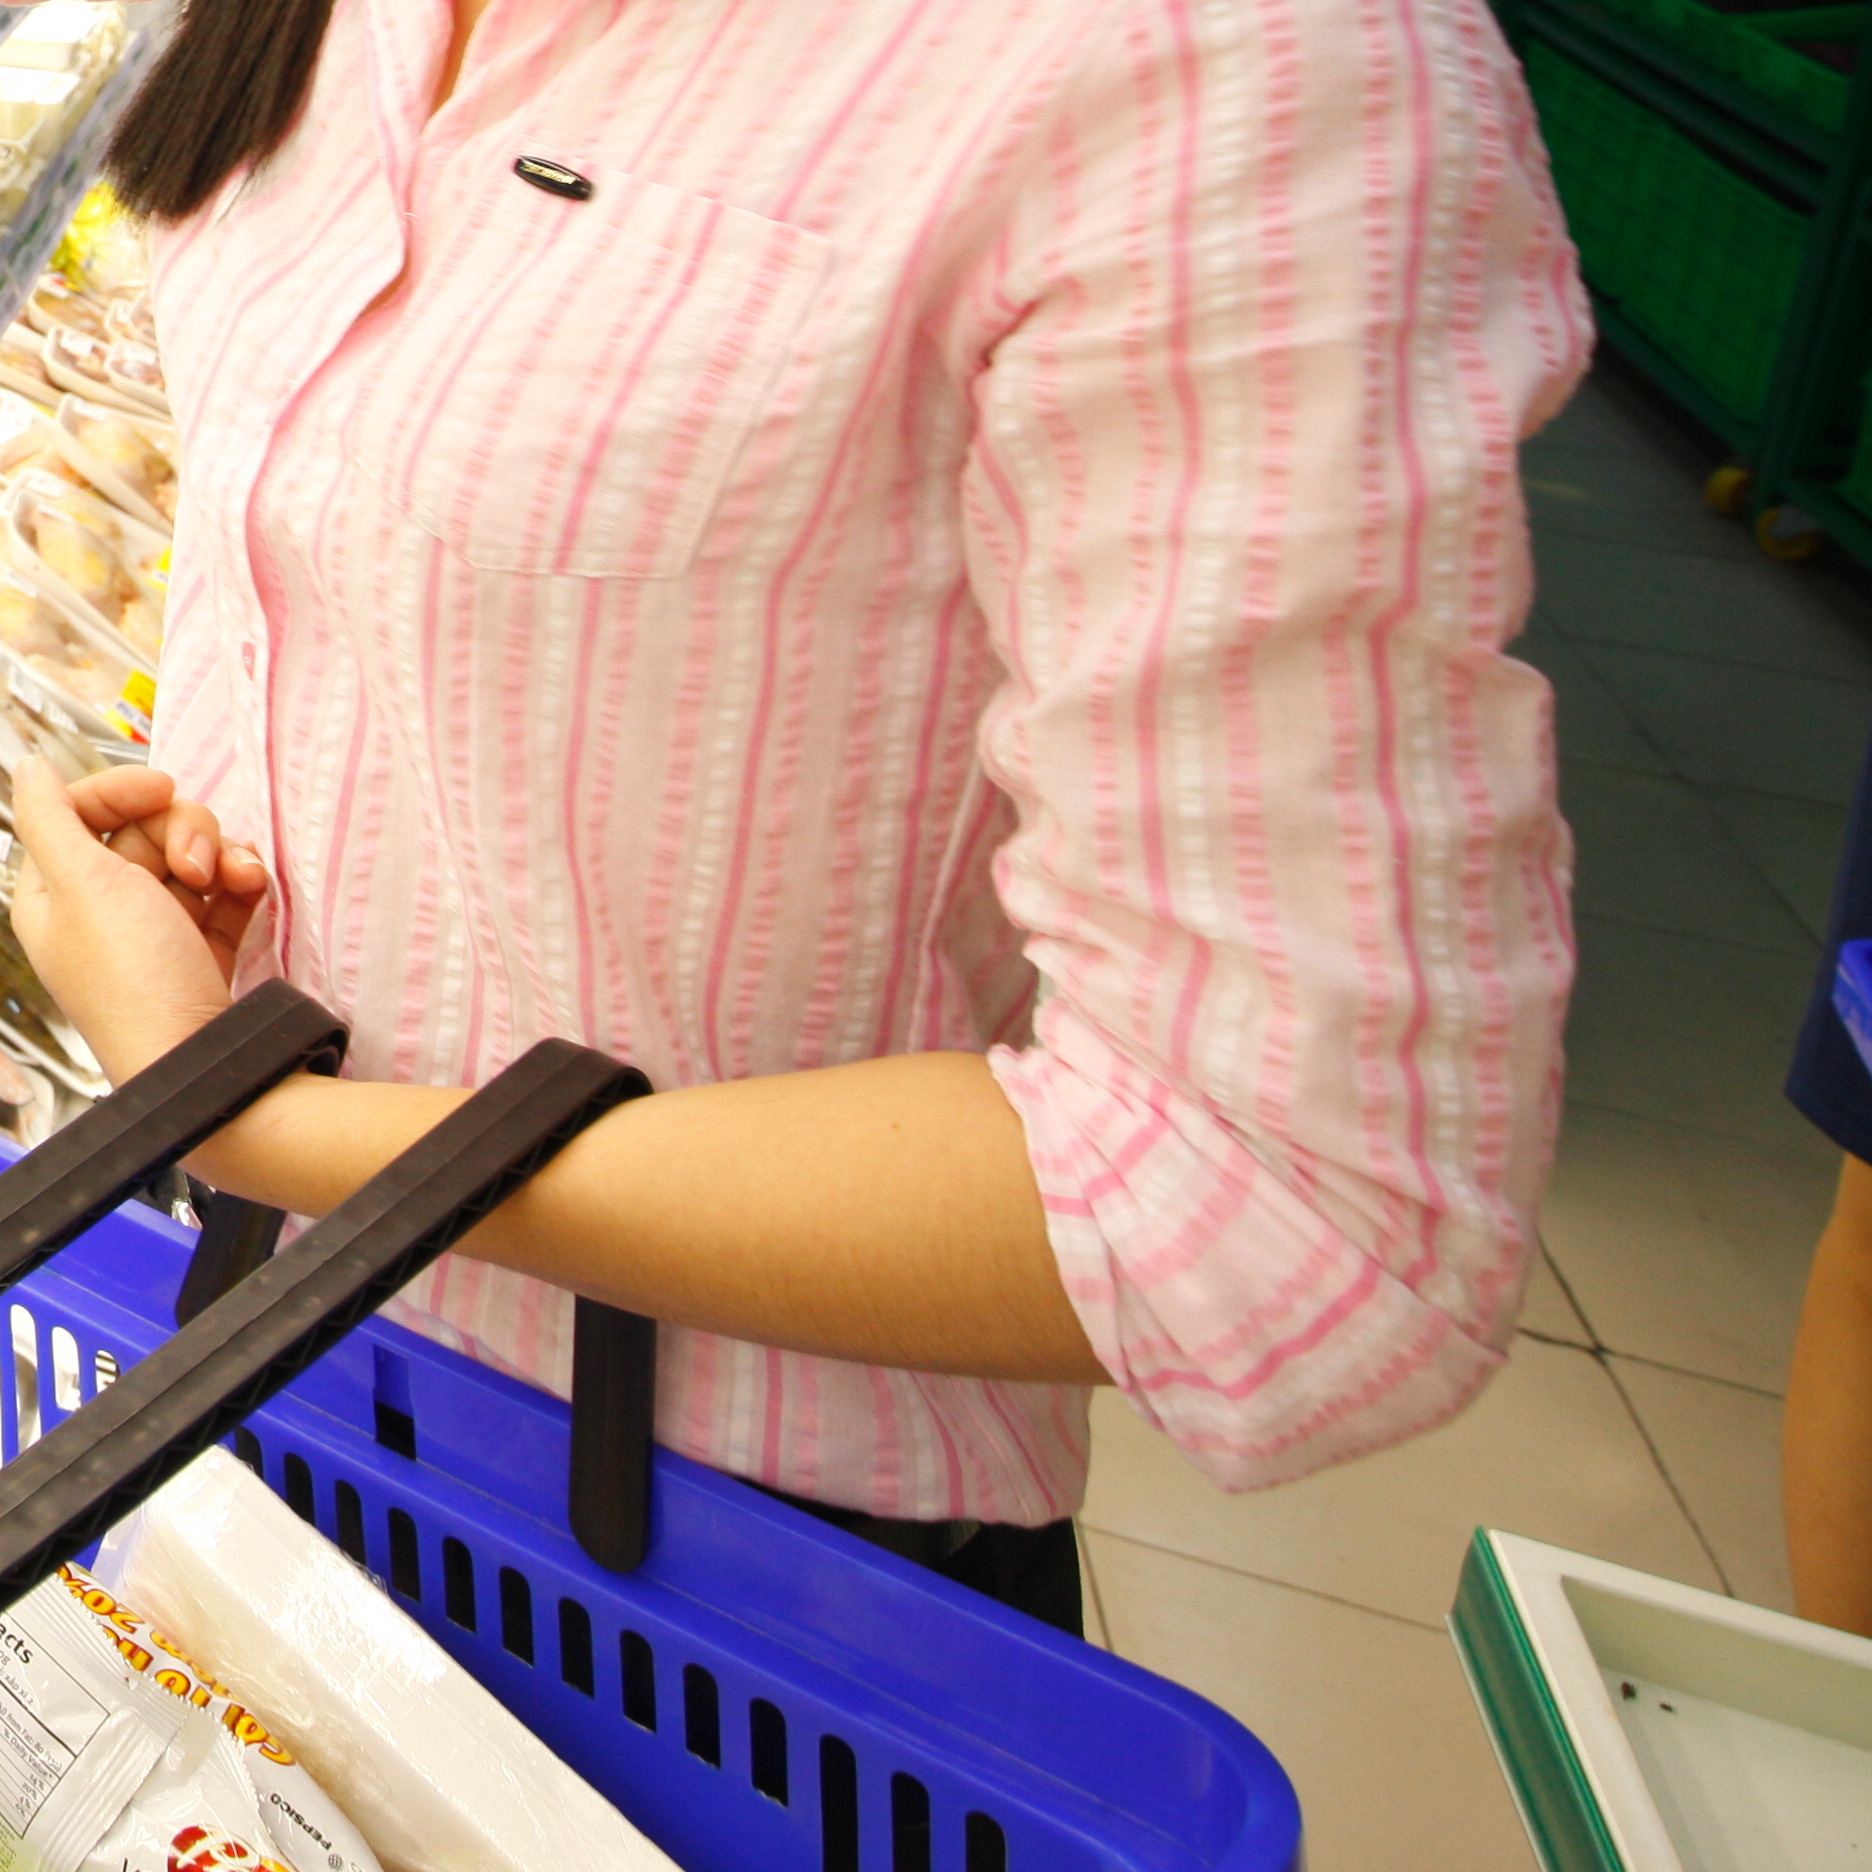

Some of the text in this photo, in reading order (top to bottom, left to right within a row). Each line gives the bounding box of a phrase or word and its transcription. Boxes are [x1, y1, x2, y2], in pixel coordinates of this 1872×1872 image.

[6, 1714, 22, 1730] from
[9, 1737, 29, 1757] Daily
[270, 1793, 332, 1850] PEPSICO
